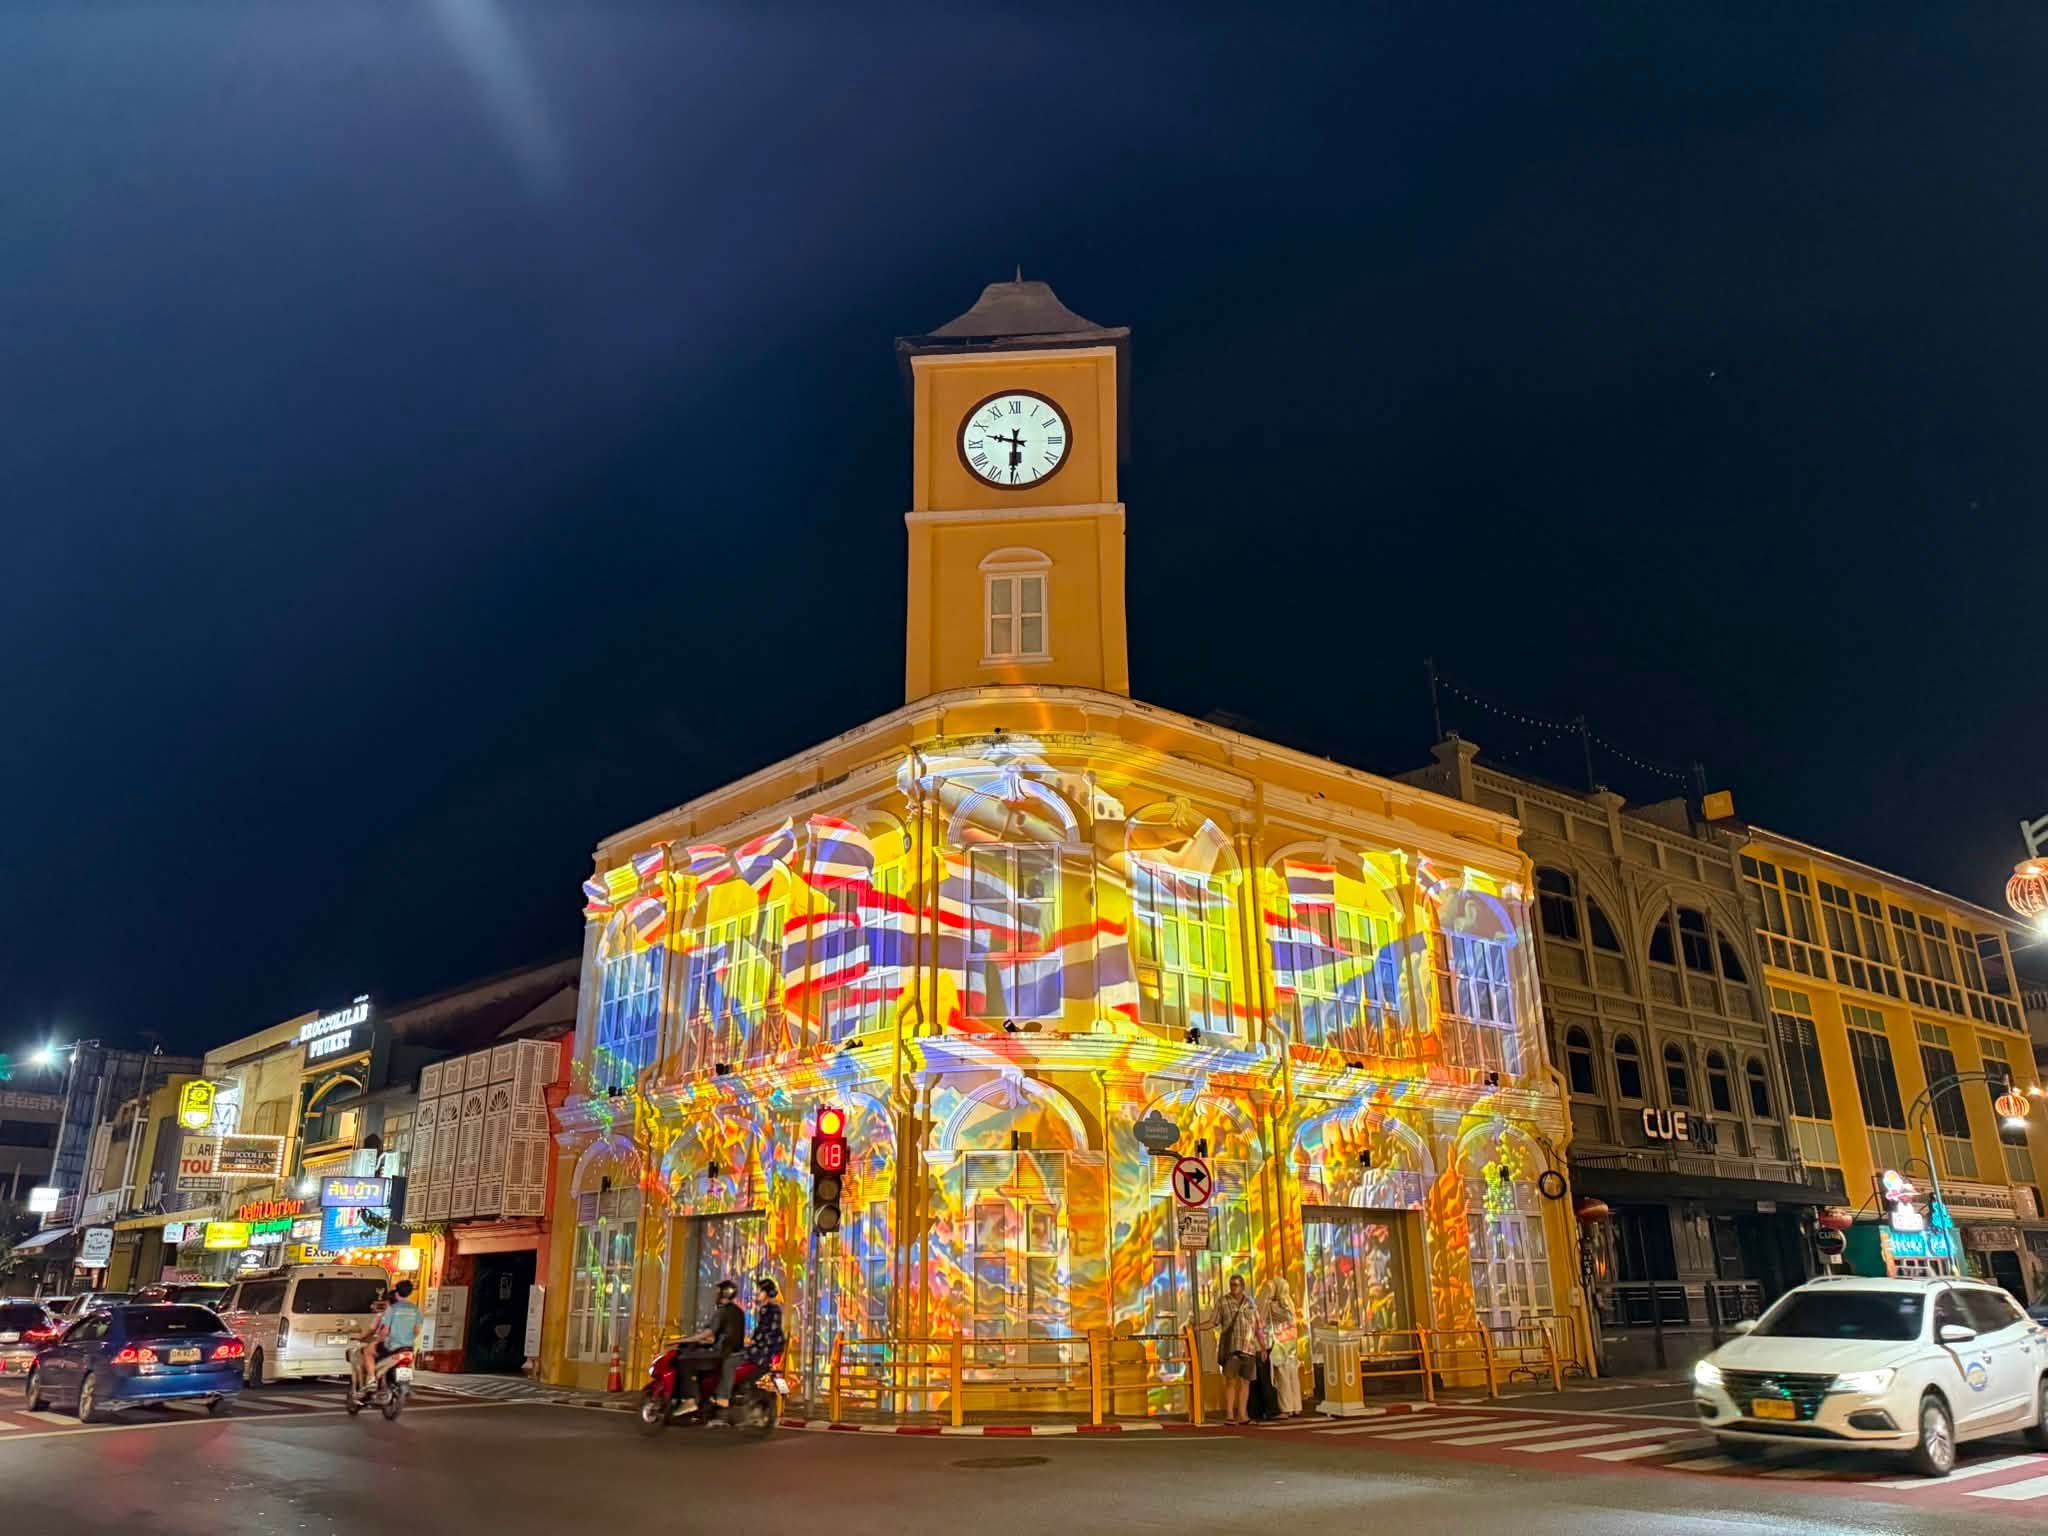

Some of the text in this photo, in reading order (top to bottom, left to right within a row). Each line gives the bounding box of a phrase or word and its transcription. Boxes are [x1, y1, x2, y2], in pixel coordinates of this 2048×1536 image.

[1009, 400, 1021, 414] XII
[299, 1003, 369, 1042] BROCCOLILAB
[309, 1029, 352, 1059] PHUKET
[1642, 1107, 1689, 1141] CUE
[824, 1144, 841, 1167] 18
[239, 1197, 305, 1222] Delhi Darbar
